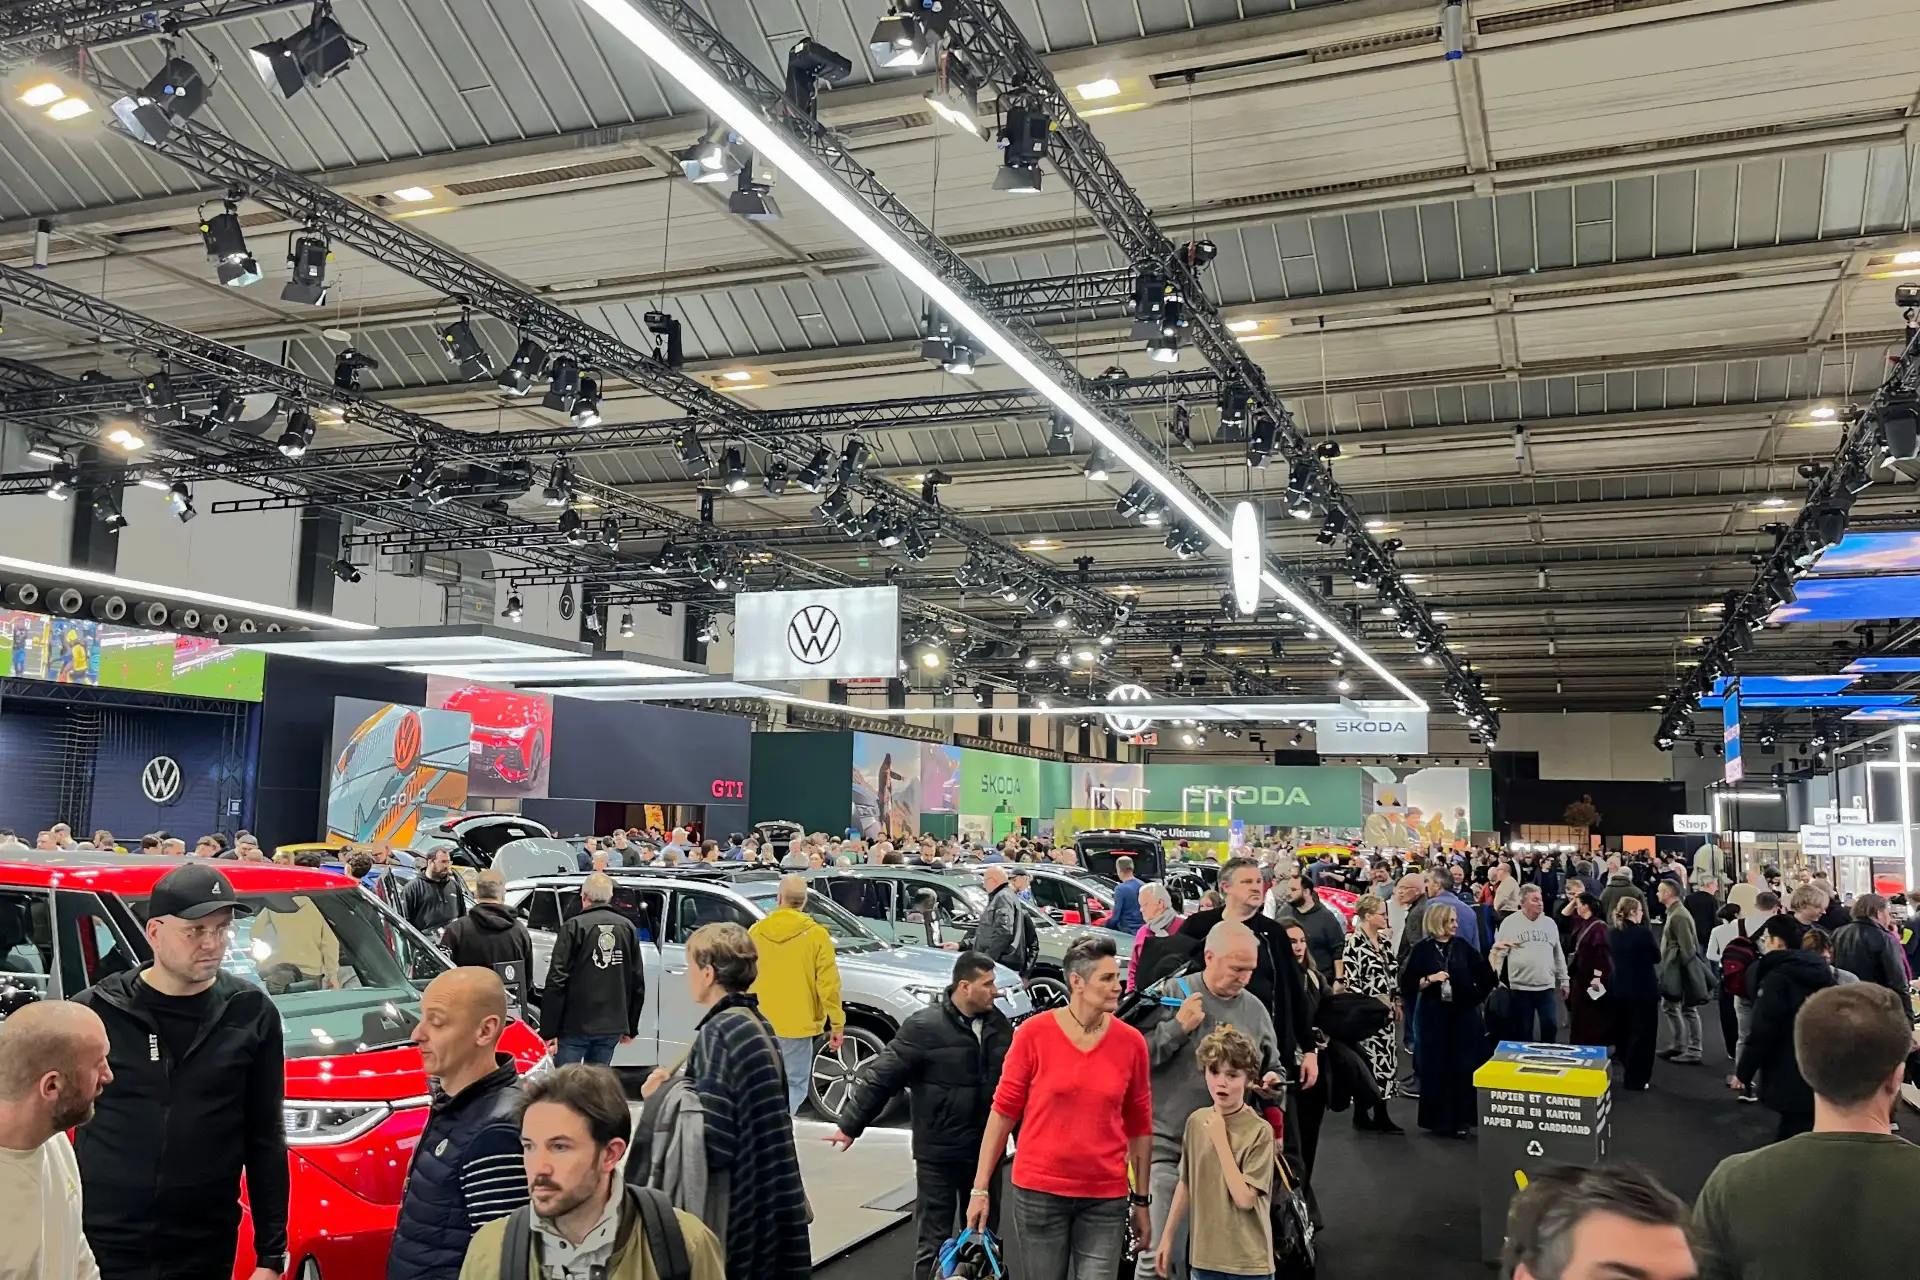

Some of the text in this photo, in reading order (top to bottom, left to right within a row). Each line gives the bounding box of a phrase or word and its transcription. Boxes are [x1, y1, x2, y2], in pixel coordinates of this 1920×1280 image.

[564, 600, 570, 613] 7
[711, 779, 744, 798] GTI
[1168, 827, 1211, 838] Ultimate
[1678, 819, 1708, 831] Shop
[1490, 1090, 1581, 1108] PAPIER ET CARTON
[1491, 1103, 1582, 1121] PAPIER EN KARTON
[1483, 1115, 1591, 1135] PAPER AND CARDBOARD
